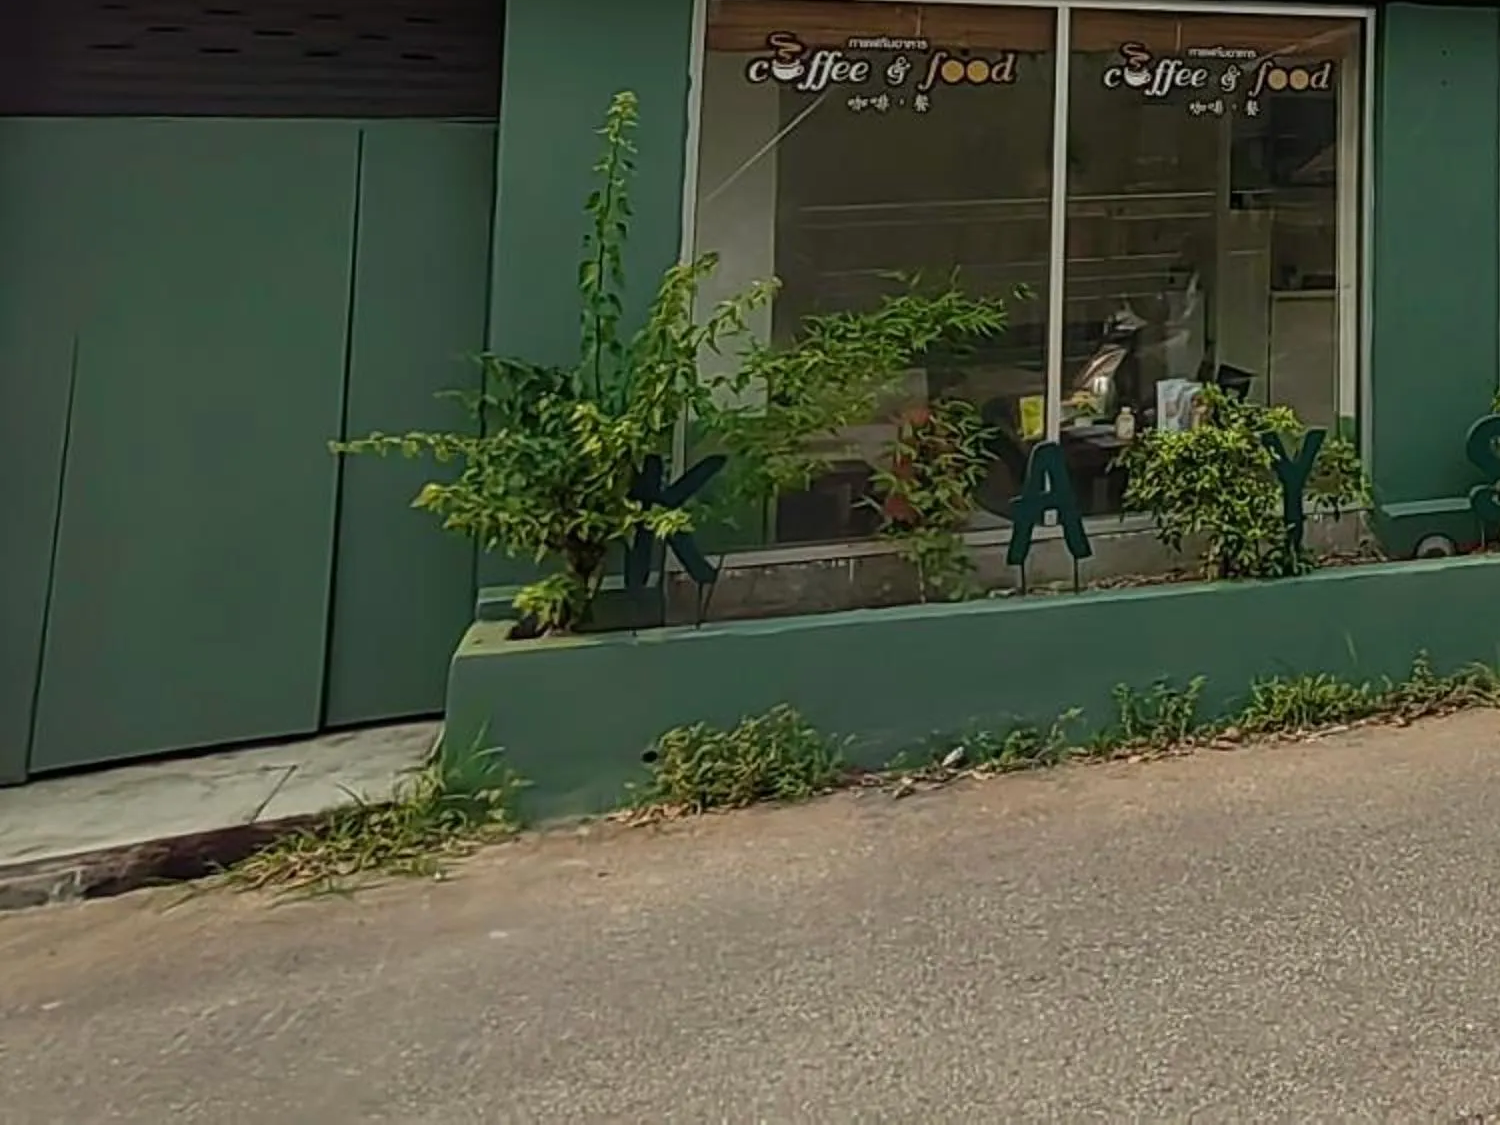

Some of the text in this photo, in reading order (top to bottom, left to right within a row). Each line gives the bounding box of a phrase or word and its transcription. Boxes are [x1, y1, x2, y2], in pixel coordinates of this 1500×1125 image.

[749, 43, 1015, 91] coffee & food
[1103, 51, 1332, 97] coffee & food
